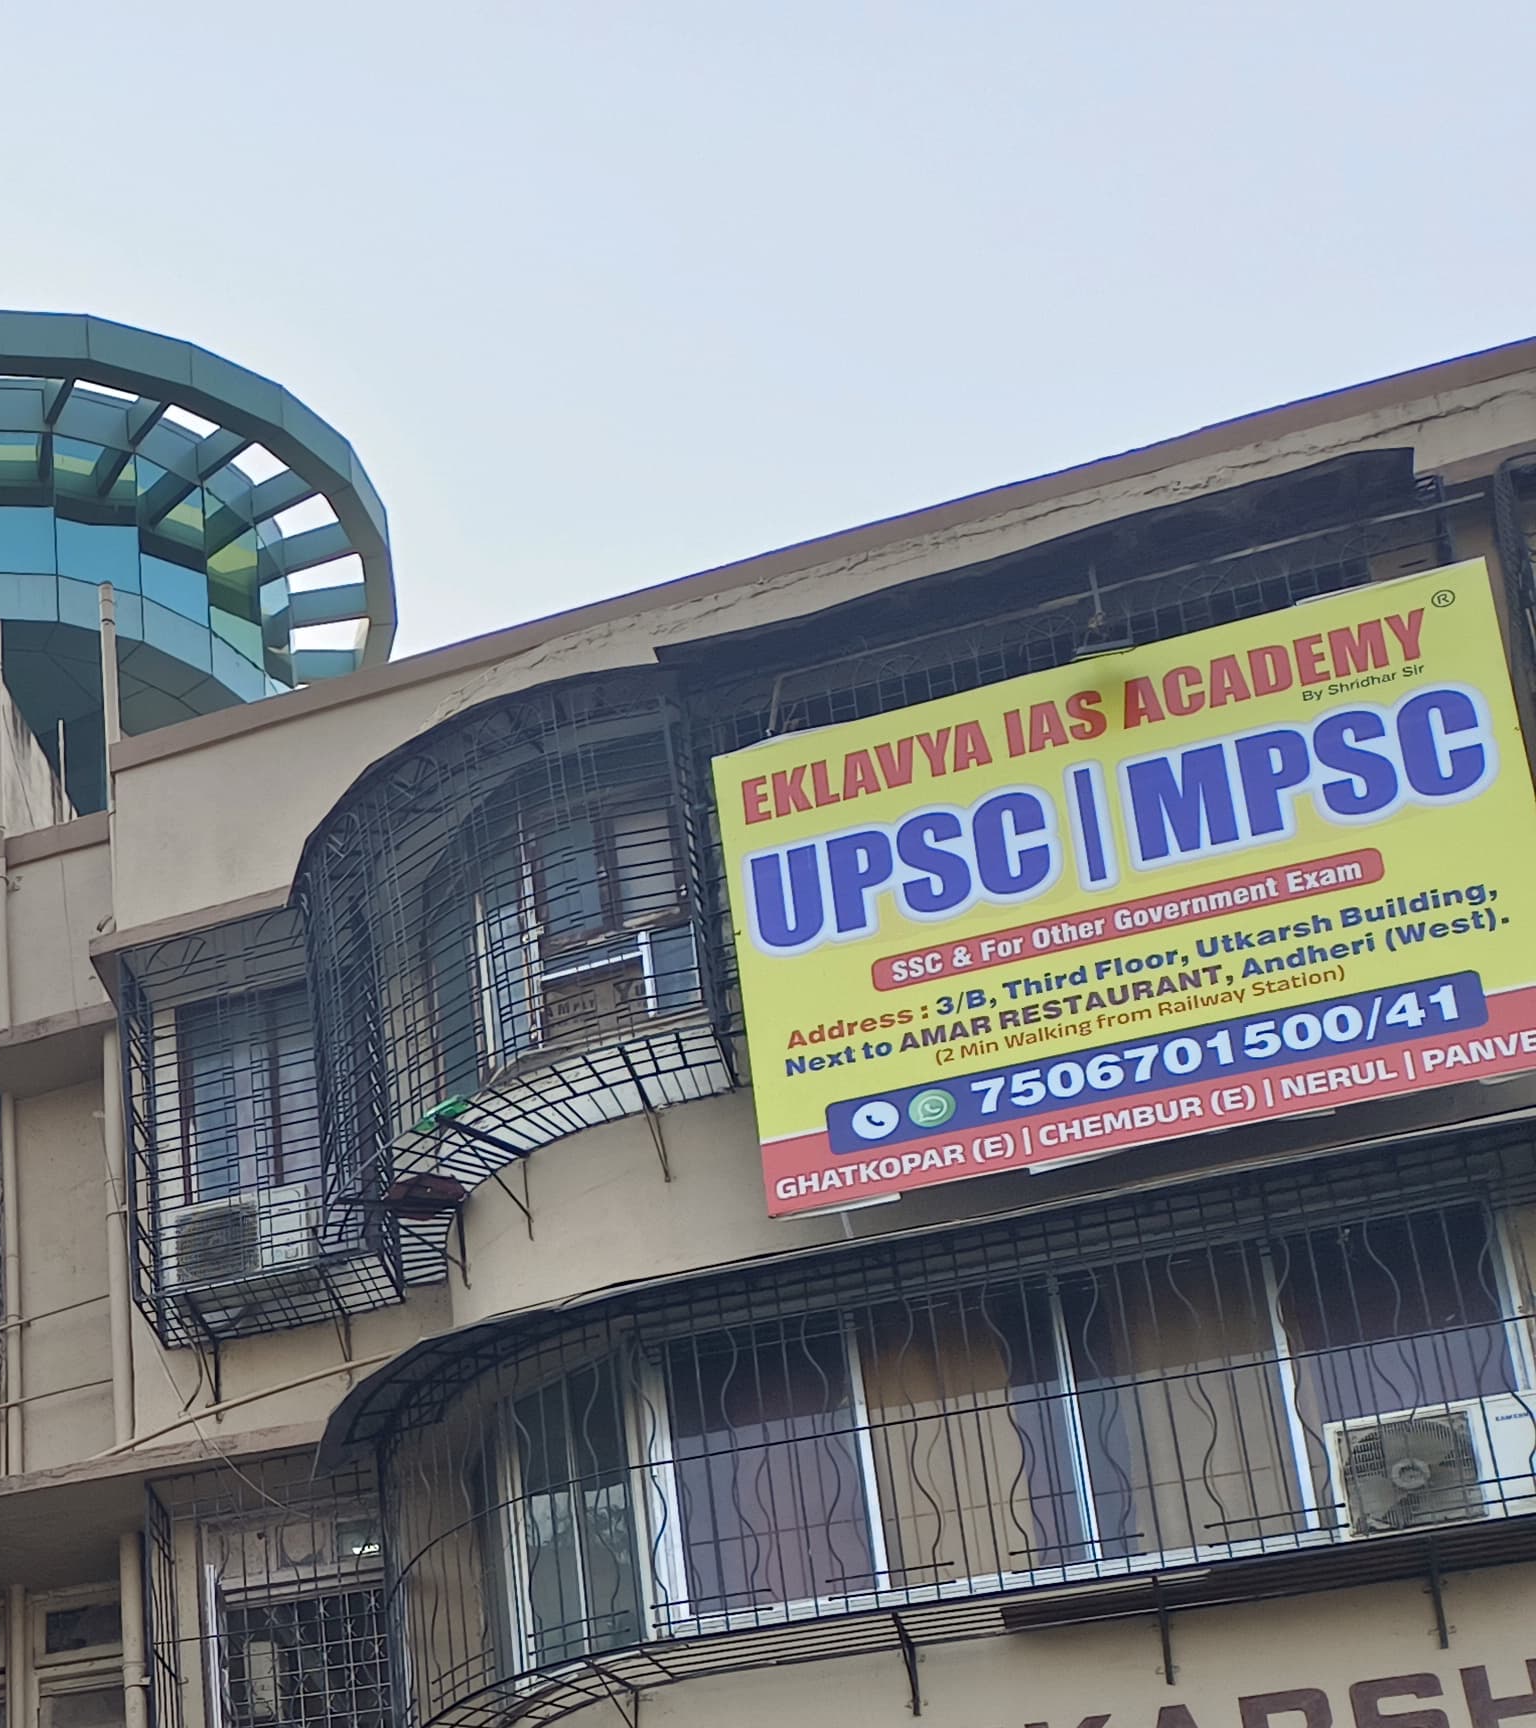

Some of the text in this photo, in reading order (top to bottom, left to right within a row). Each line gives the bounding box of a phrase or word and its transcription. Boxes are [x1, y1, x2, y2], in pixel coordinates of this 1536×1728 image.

[741, 609, 1426, 825] EKLAVYA IAS ACADEMY
[1302, 664, 1424, 701] By Shridhar Sir
[750, 689, 1486, 948] UPSC MPSC
[787, 882, 1499, 1049] Address 3/B, Third Floor, Utkarsh Building,
[892, 859, 1362, 982] SSC For Other Government Exam
[785, 908, 1510, 1077] Next to AMAR RESTAURANT, Andheri (West).
[960, 966, 1345, 1060] Min Walking from Railway Station)
[970, 984, 1459, 1115] 7506701500/41
[776, 1060, 1397, 1200] GHATKOPAR (E) CHEMBUR (E) NERUL
